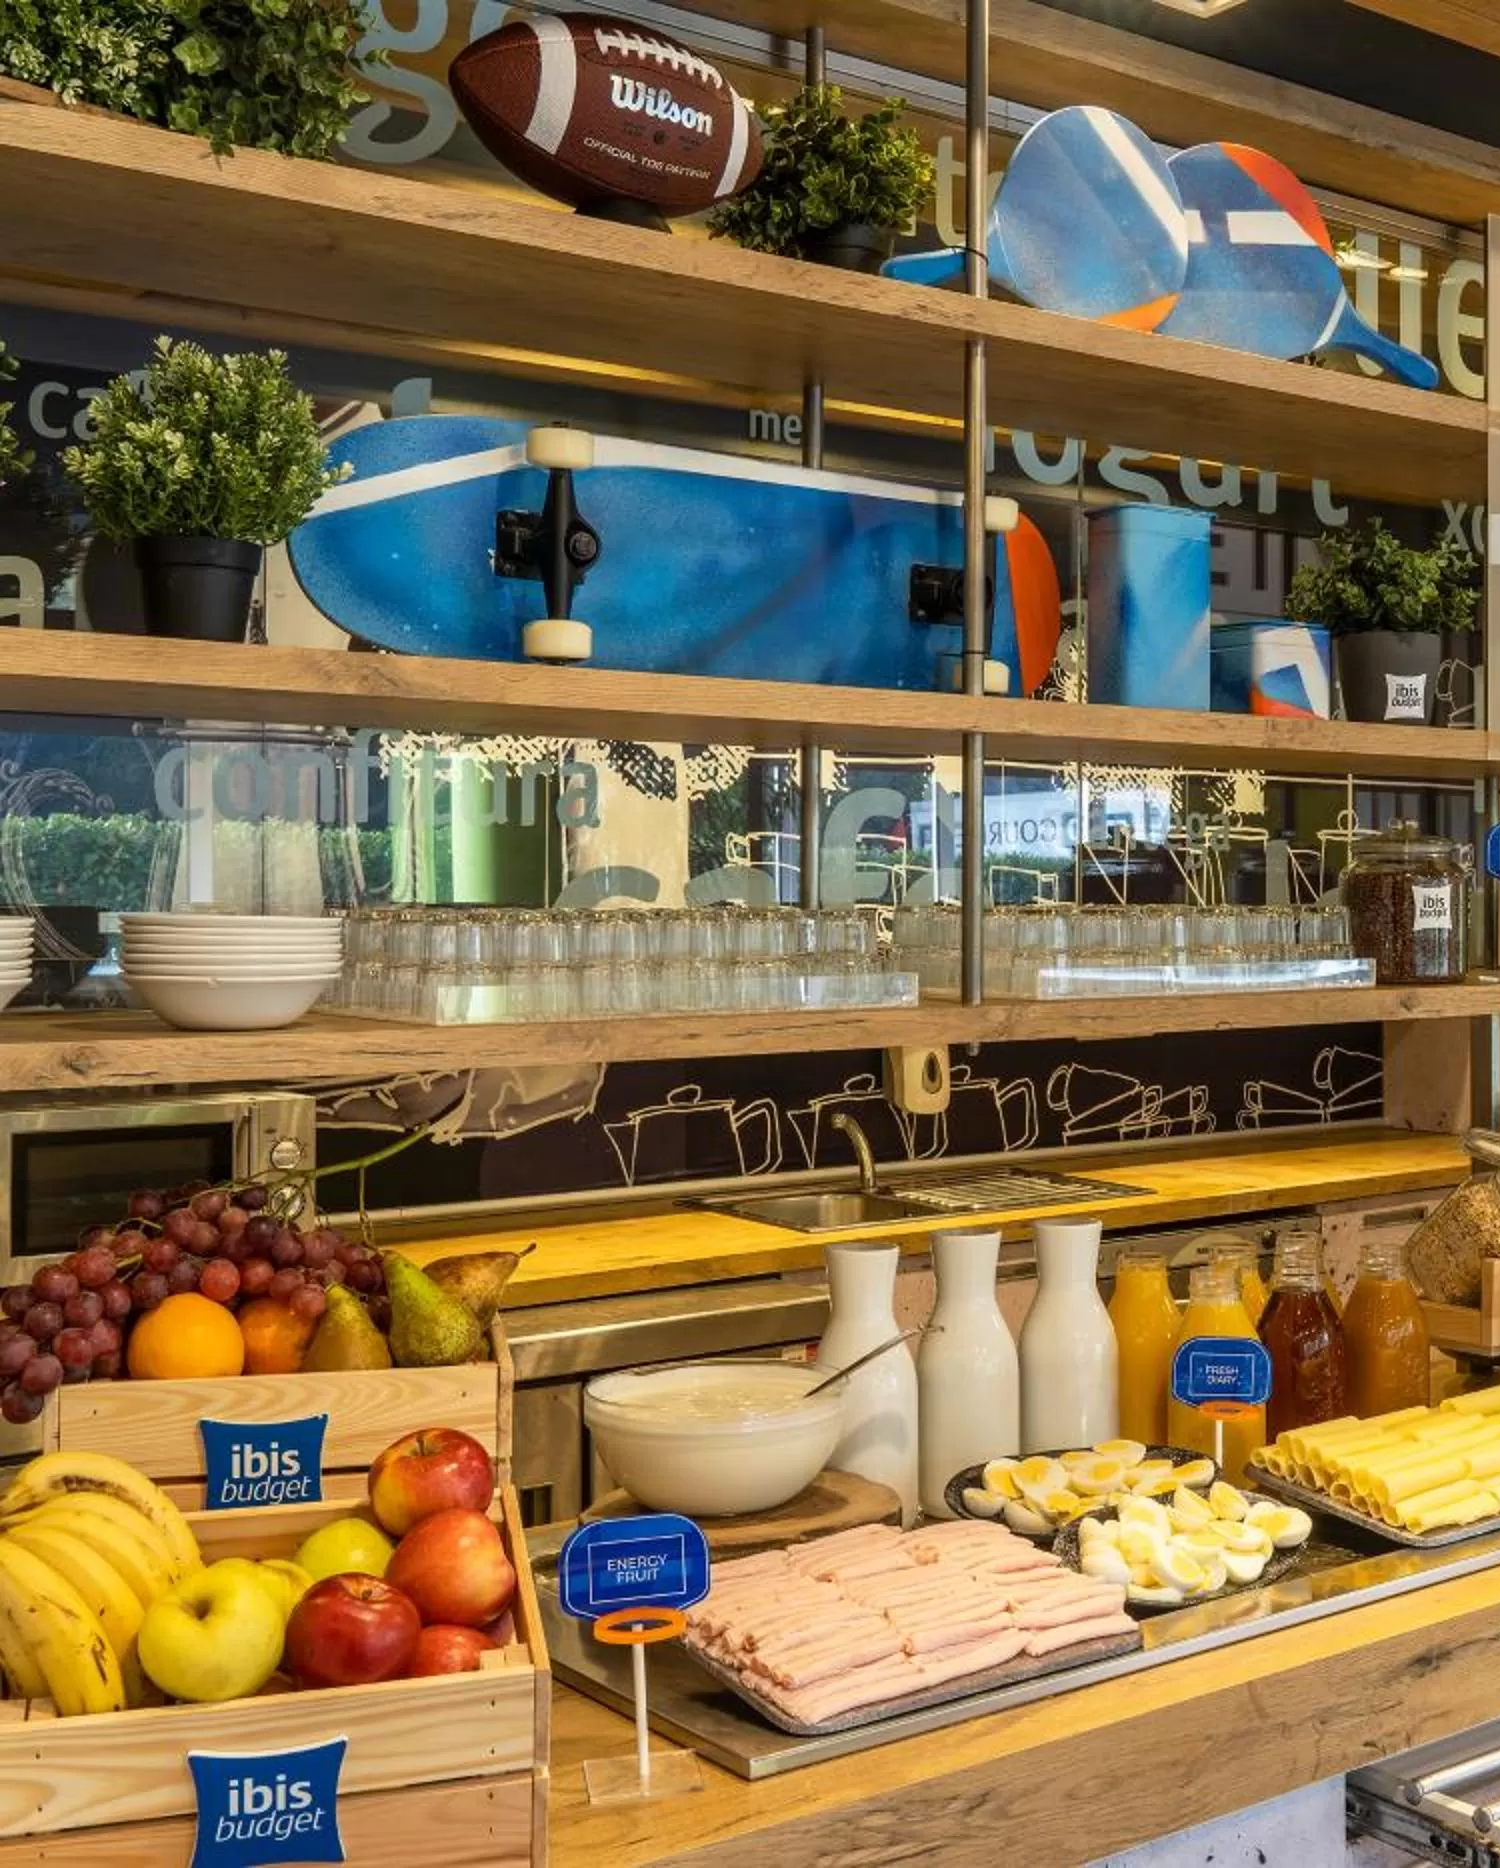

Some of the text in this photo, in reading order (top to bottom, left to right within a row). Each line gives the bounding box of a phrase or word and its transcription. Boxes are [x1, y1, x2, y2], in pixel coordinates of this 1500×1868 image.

[610, 73, 713, 137] Wilson
[583, 136, 637, 164] OFFICIAL
[1395, 683, 1419, 697] ibis
[153, 726, 602, 828] confitura
[1422, 894, 1446, 909] ibis
[1205, 1364, 1239, 1375] FRESH
[231, 1441, 301, 1479] ibis
[220, 1475, 313, 1505] budget
[606, 1552, 669, 1571] ENERGY
[615, 1567, 661, 1585] FRUIT
[228, 1773, 313, 1817] ibis
[214, 1807, 326, 1843] budget
